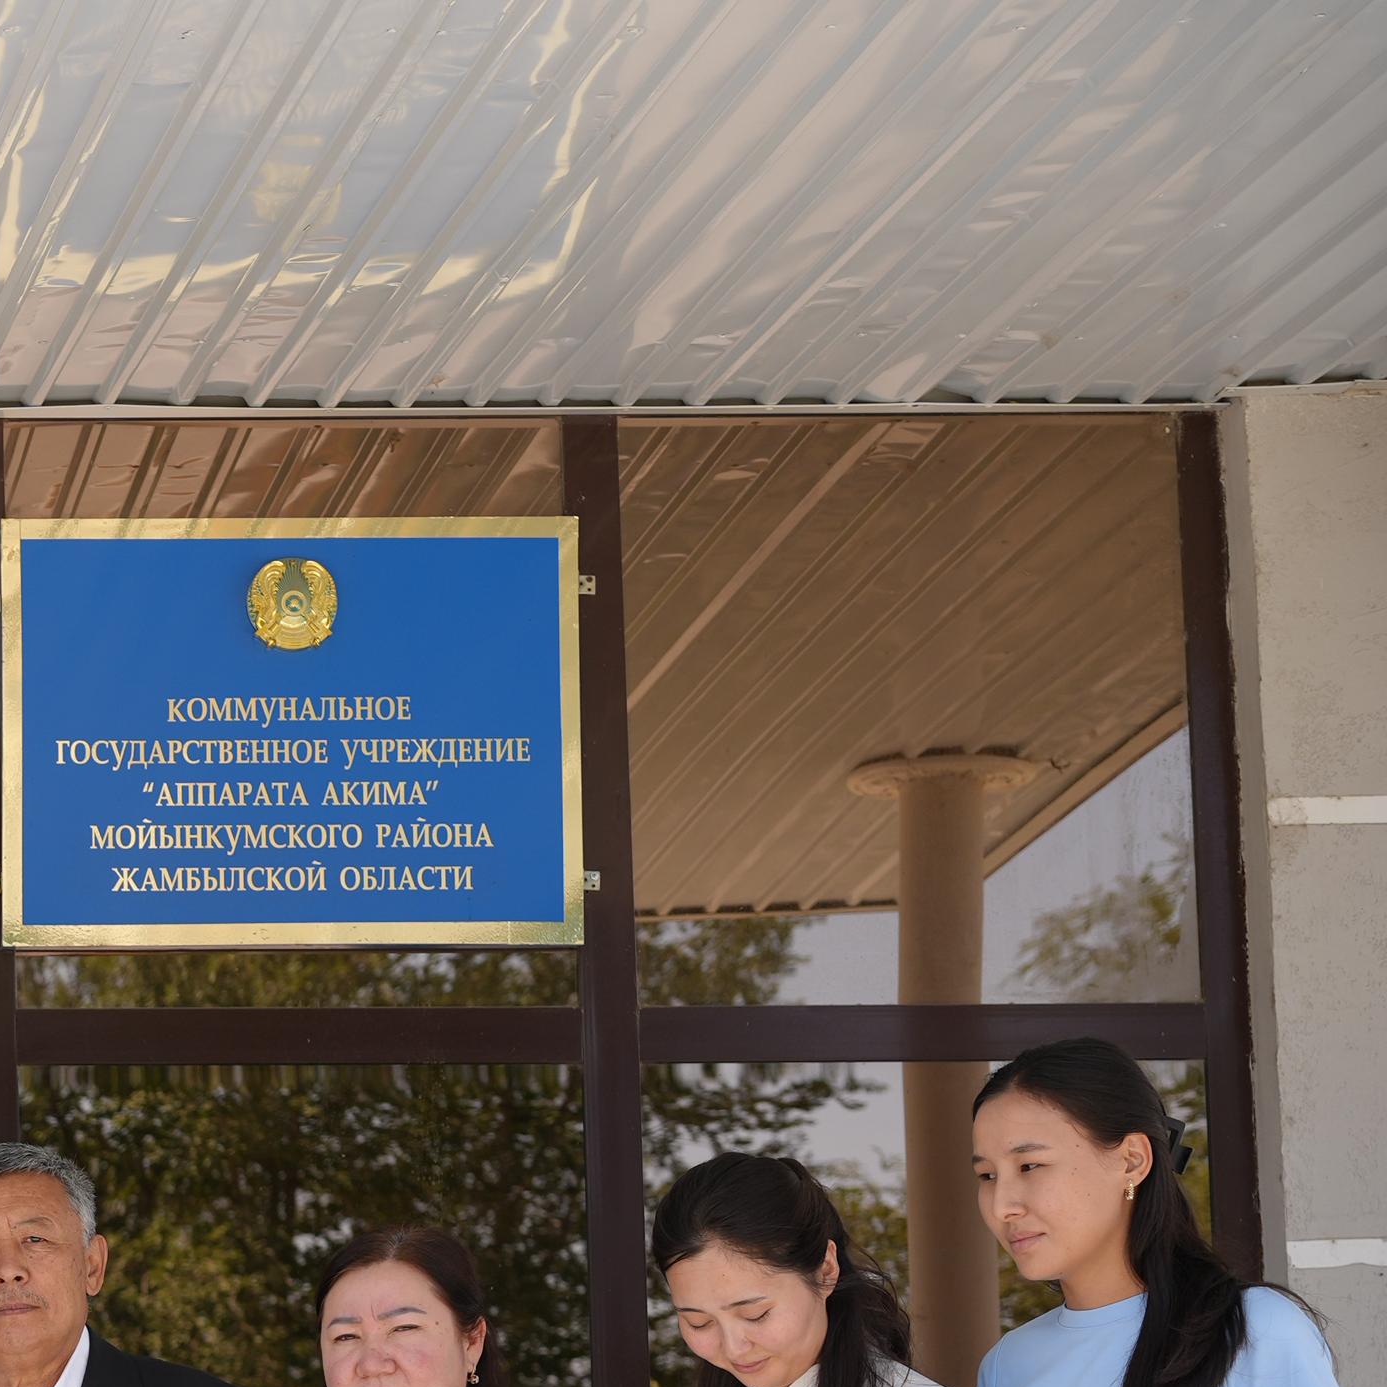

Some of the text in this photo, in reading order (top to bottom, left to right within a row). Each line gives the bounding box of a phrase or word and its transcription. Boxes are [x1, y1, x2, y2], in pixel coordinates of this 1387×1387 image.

[167, 696, 412, 728] КОММУНАЛЬНОЕ
[55, 737, 531, 771] ГОСУДАРСТВЕННОЕ УЧРЕЖДЕНИЕ
[142, 779, 439, 807] “АППАРАТА АКИМА”
[89, 816, 495, 856] МОЙЫНКУМСКОГО РАЙОНА
[111, 860, 474, 892] ЖАМБЫЛСКОЙ ОБЛАСТИ
